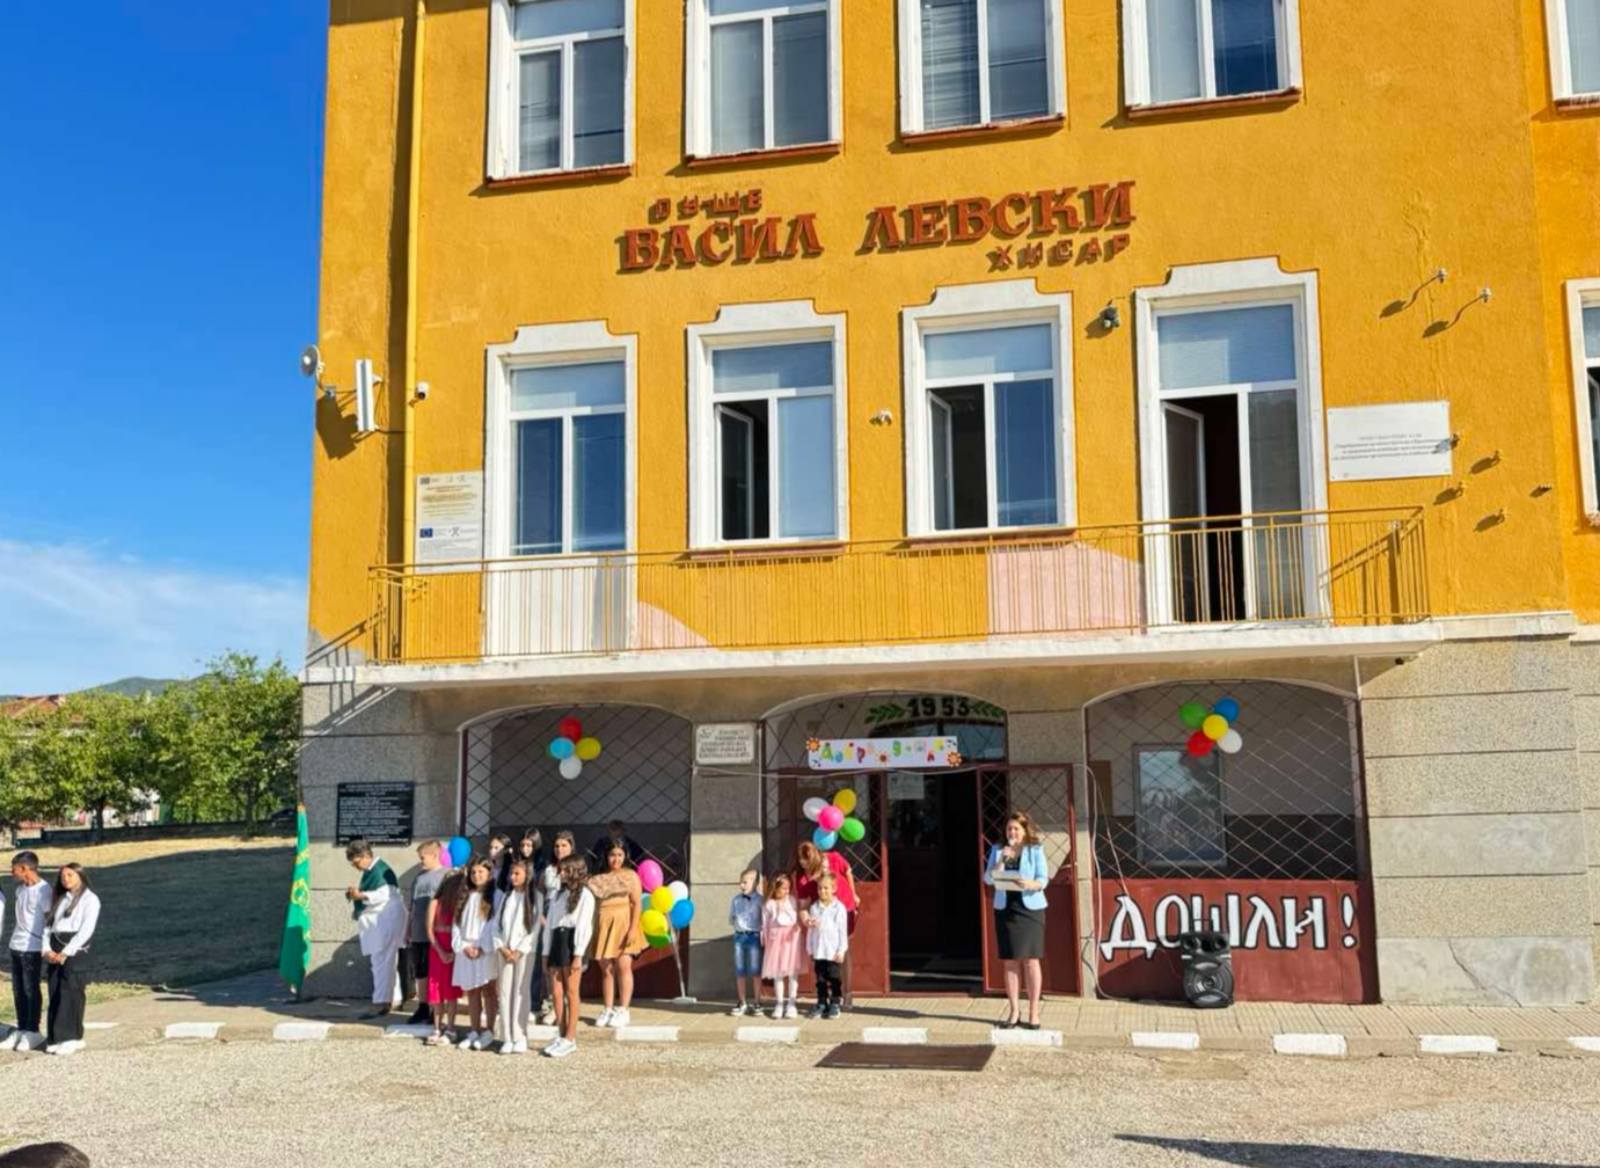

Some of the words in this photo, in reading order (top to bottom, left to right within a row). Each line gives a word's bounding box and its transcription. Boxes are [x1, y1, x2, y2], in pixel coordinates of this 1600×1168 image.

[619, 212, 825, 272] ВАСИЛ
[858, 180, 1137, 253] ЛЕВСКИ
[988, 233, 1130, 270] ХИСАР
[908, 696, 970, 717] 1953
